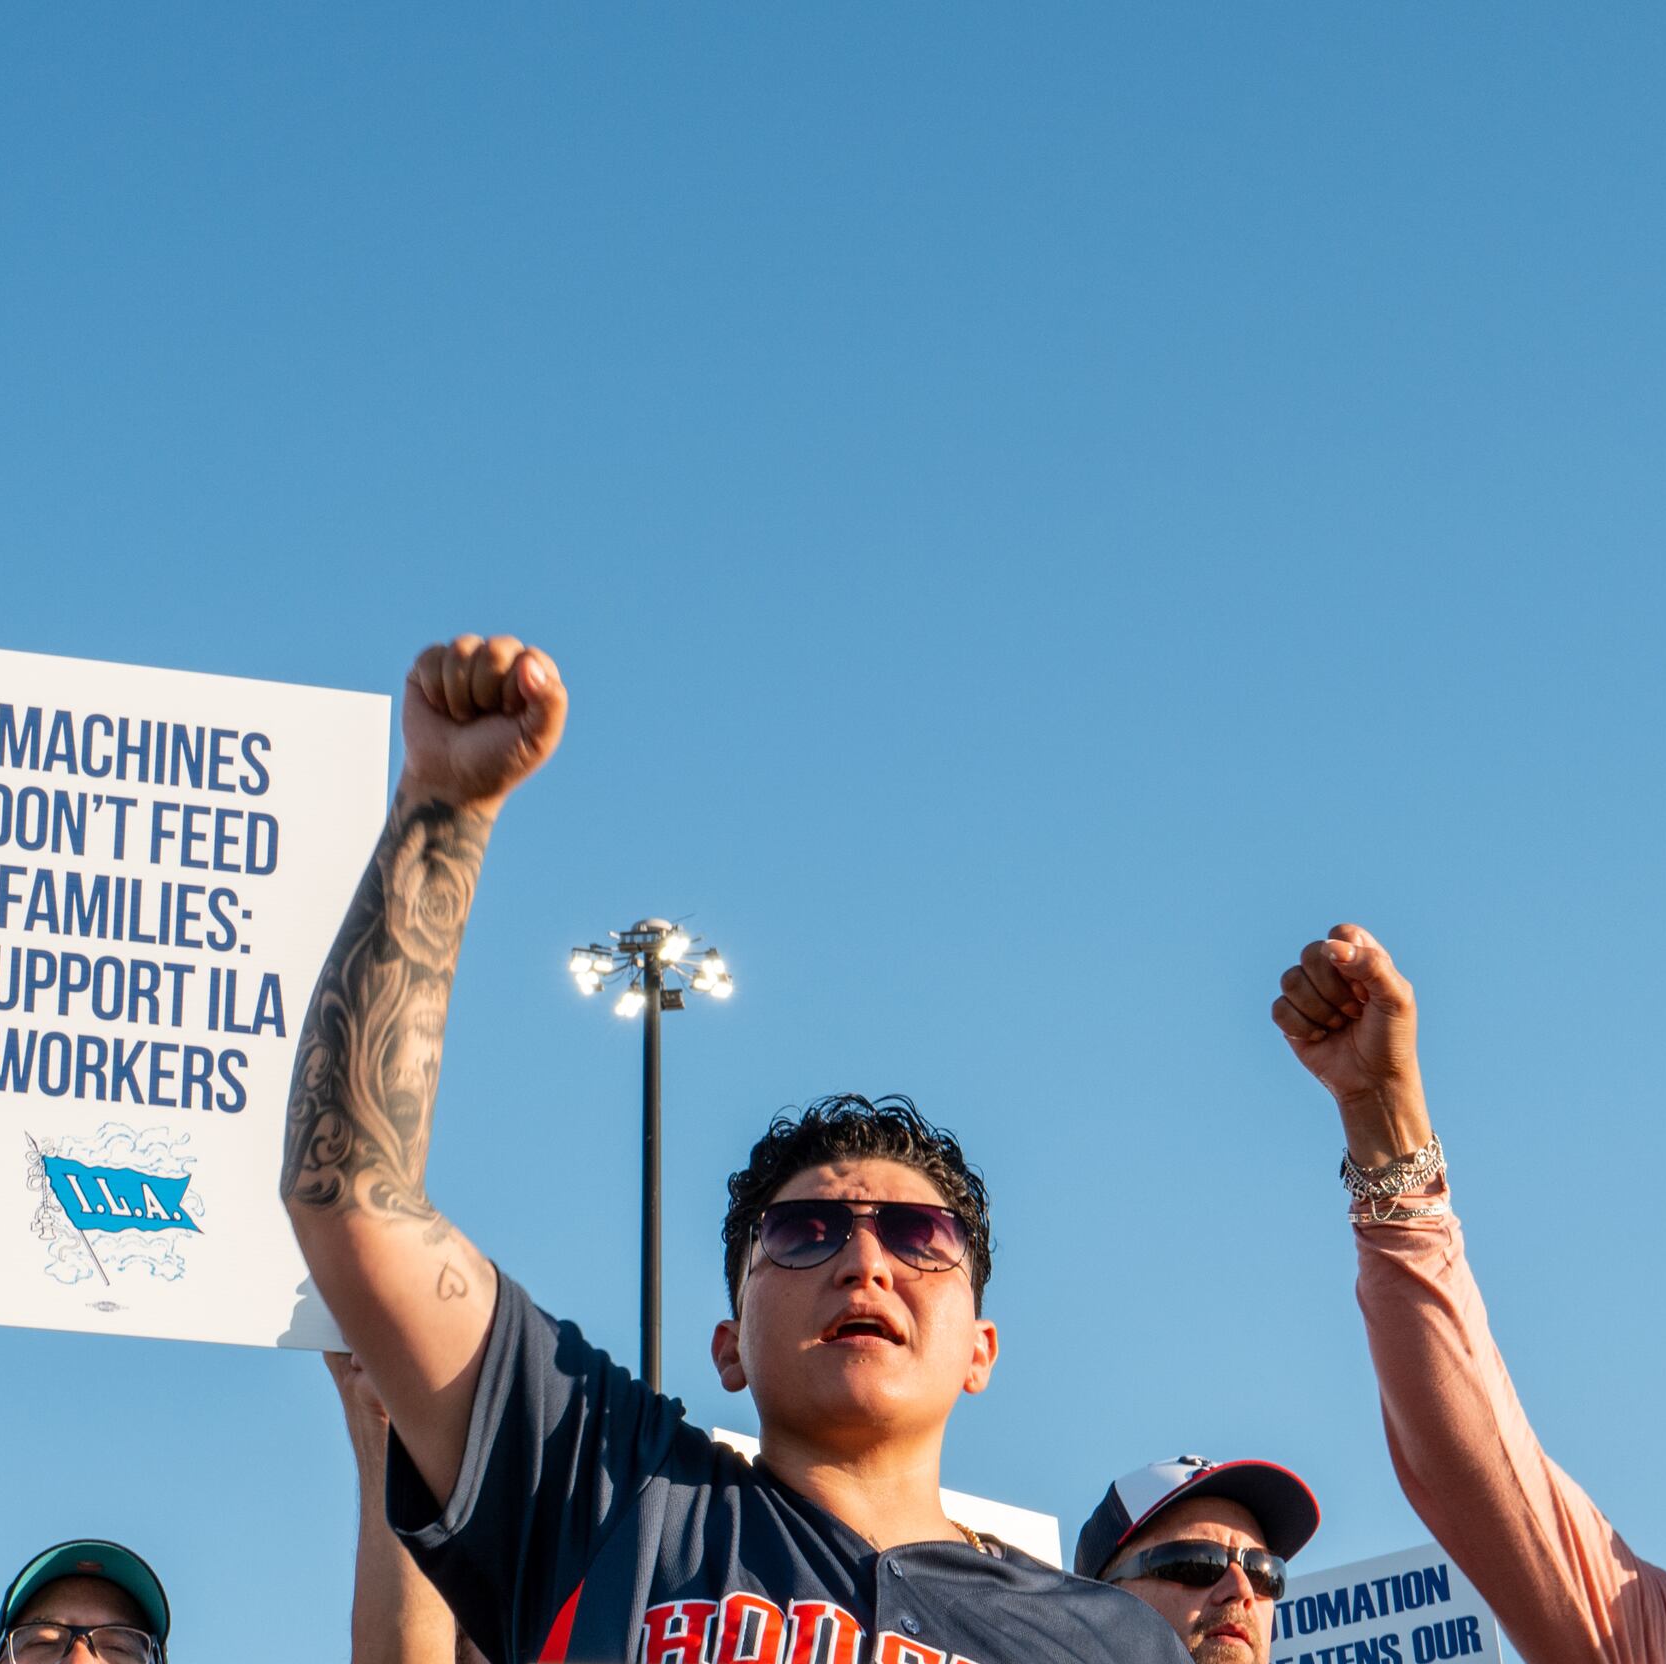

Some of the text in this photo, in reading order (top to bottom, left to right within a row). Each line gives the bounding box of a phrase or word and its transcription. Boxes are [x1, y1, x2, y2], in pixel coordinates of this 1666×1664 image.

[150, 804, 279, 875] FEED
[208, 967, 287, 1038] ILA
[65, 1173, 182, 1224] I.L.A.
[1412, 1615, 1483, 1664] OUR
